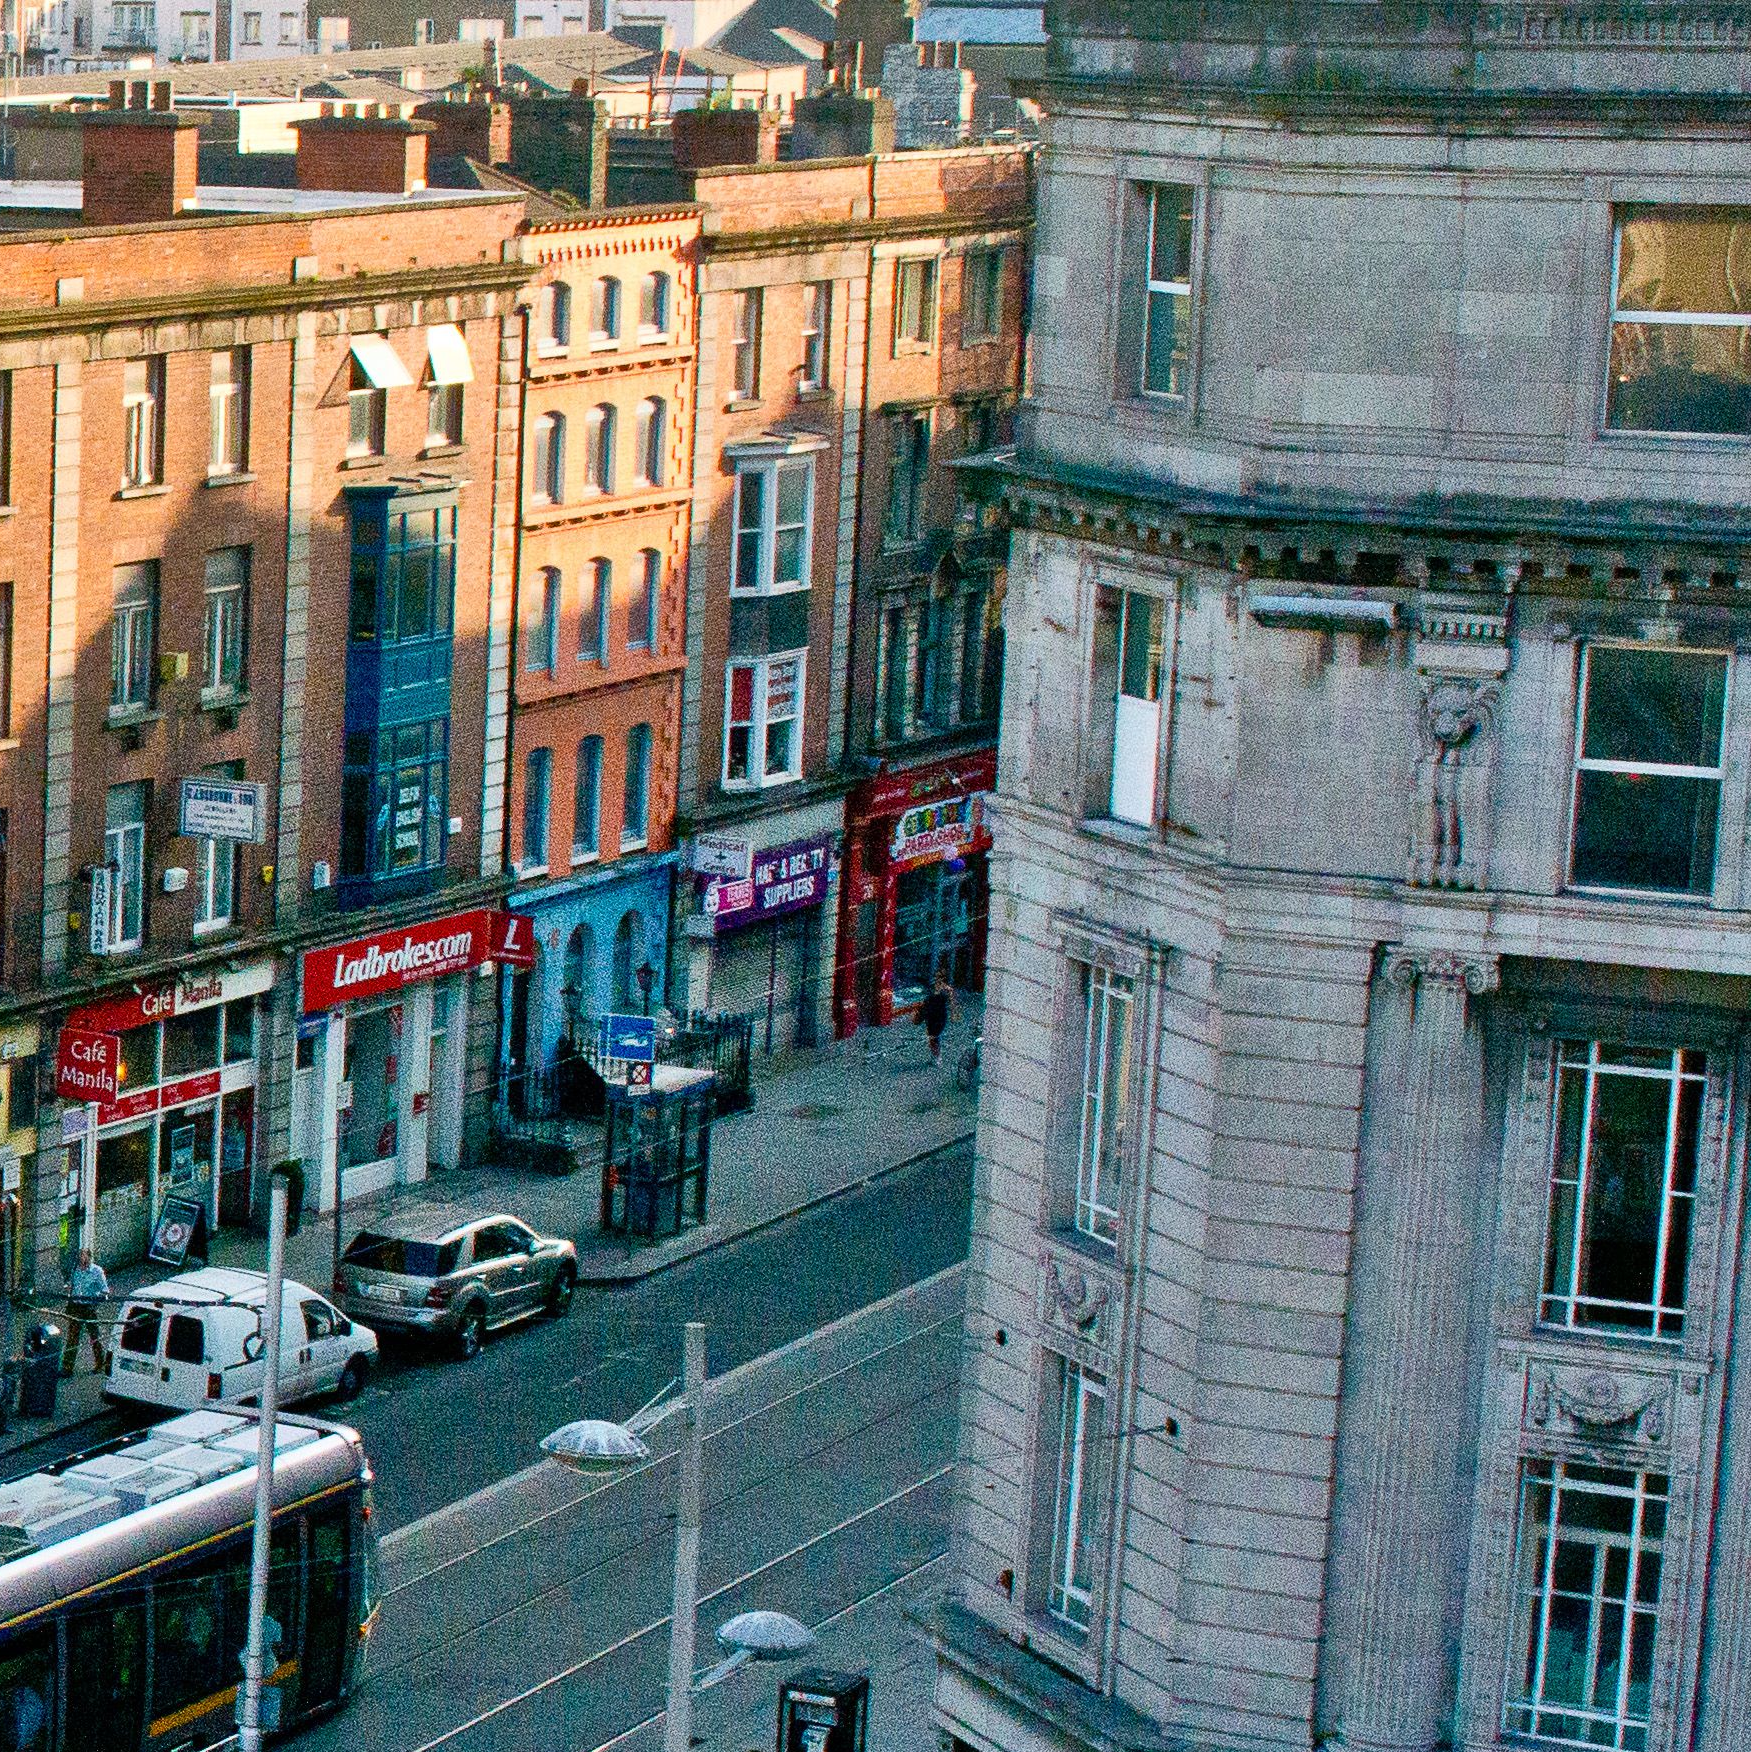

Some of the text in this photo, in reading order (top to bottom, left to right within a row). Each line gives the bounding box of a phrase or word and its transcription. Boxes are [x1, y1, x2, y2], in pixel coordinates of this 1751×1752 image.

[504, 919, 520, 951] L
[142, 985, 172, 1016] Café
[71, 1040, 107, 1064] Café
[61, 1066, 113, 1092] Manila
